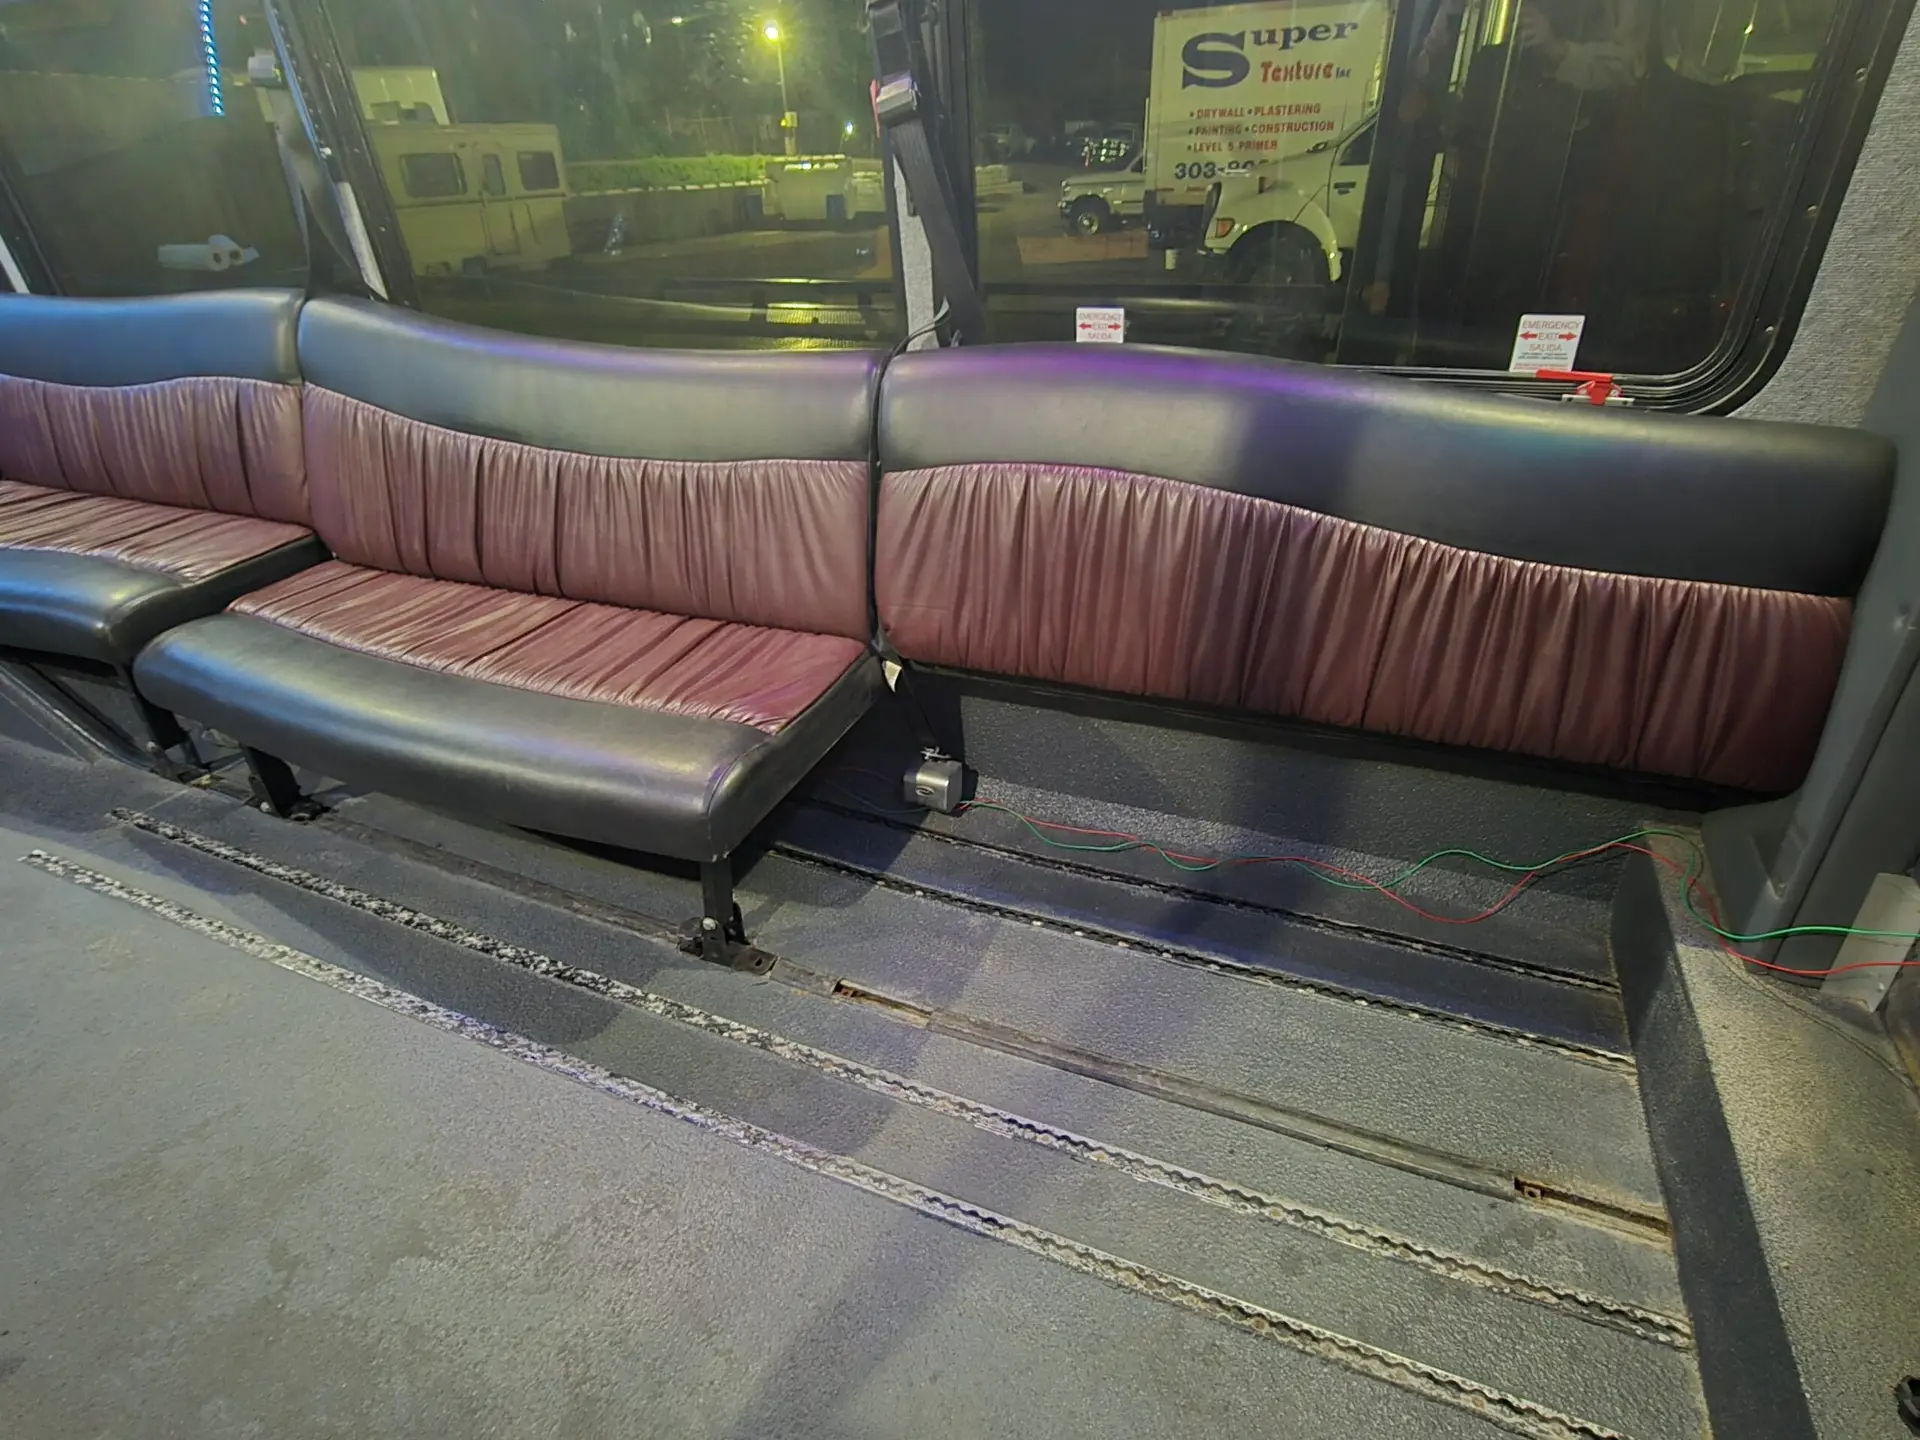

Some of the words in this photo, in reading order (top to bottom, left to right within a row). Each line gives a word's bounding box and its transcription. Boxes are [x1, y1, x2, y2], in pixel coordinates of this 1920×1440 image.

[1182, 22, 1358, 90] Super
[1260, 60, 1333, 83] Texture
[1196, 108, 1245, 119] DRYWALL
[1254, 103, 1321, 116] PLASTERING
[1195, 125, 1242, 136] PAINTING
[1251, 121, 1335, 133] CONSTRUCTION
[1193, 142, 1223, 152] LEVEL
[1238, 140, 1278, 152] PRIMER
[1521, 320, 1580, 330] EMERGENCY
[1538, 332, 1560, 340] EXIT
[1529, 343, 1563, 352] SALIDA
